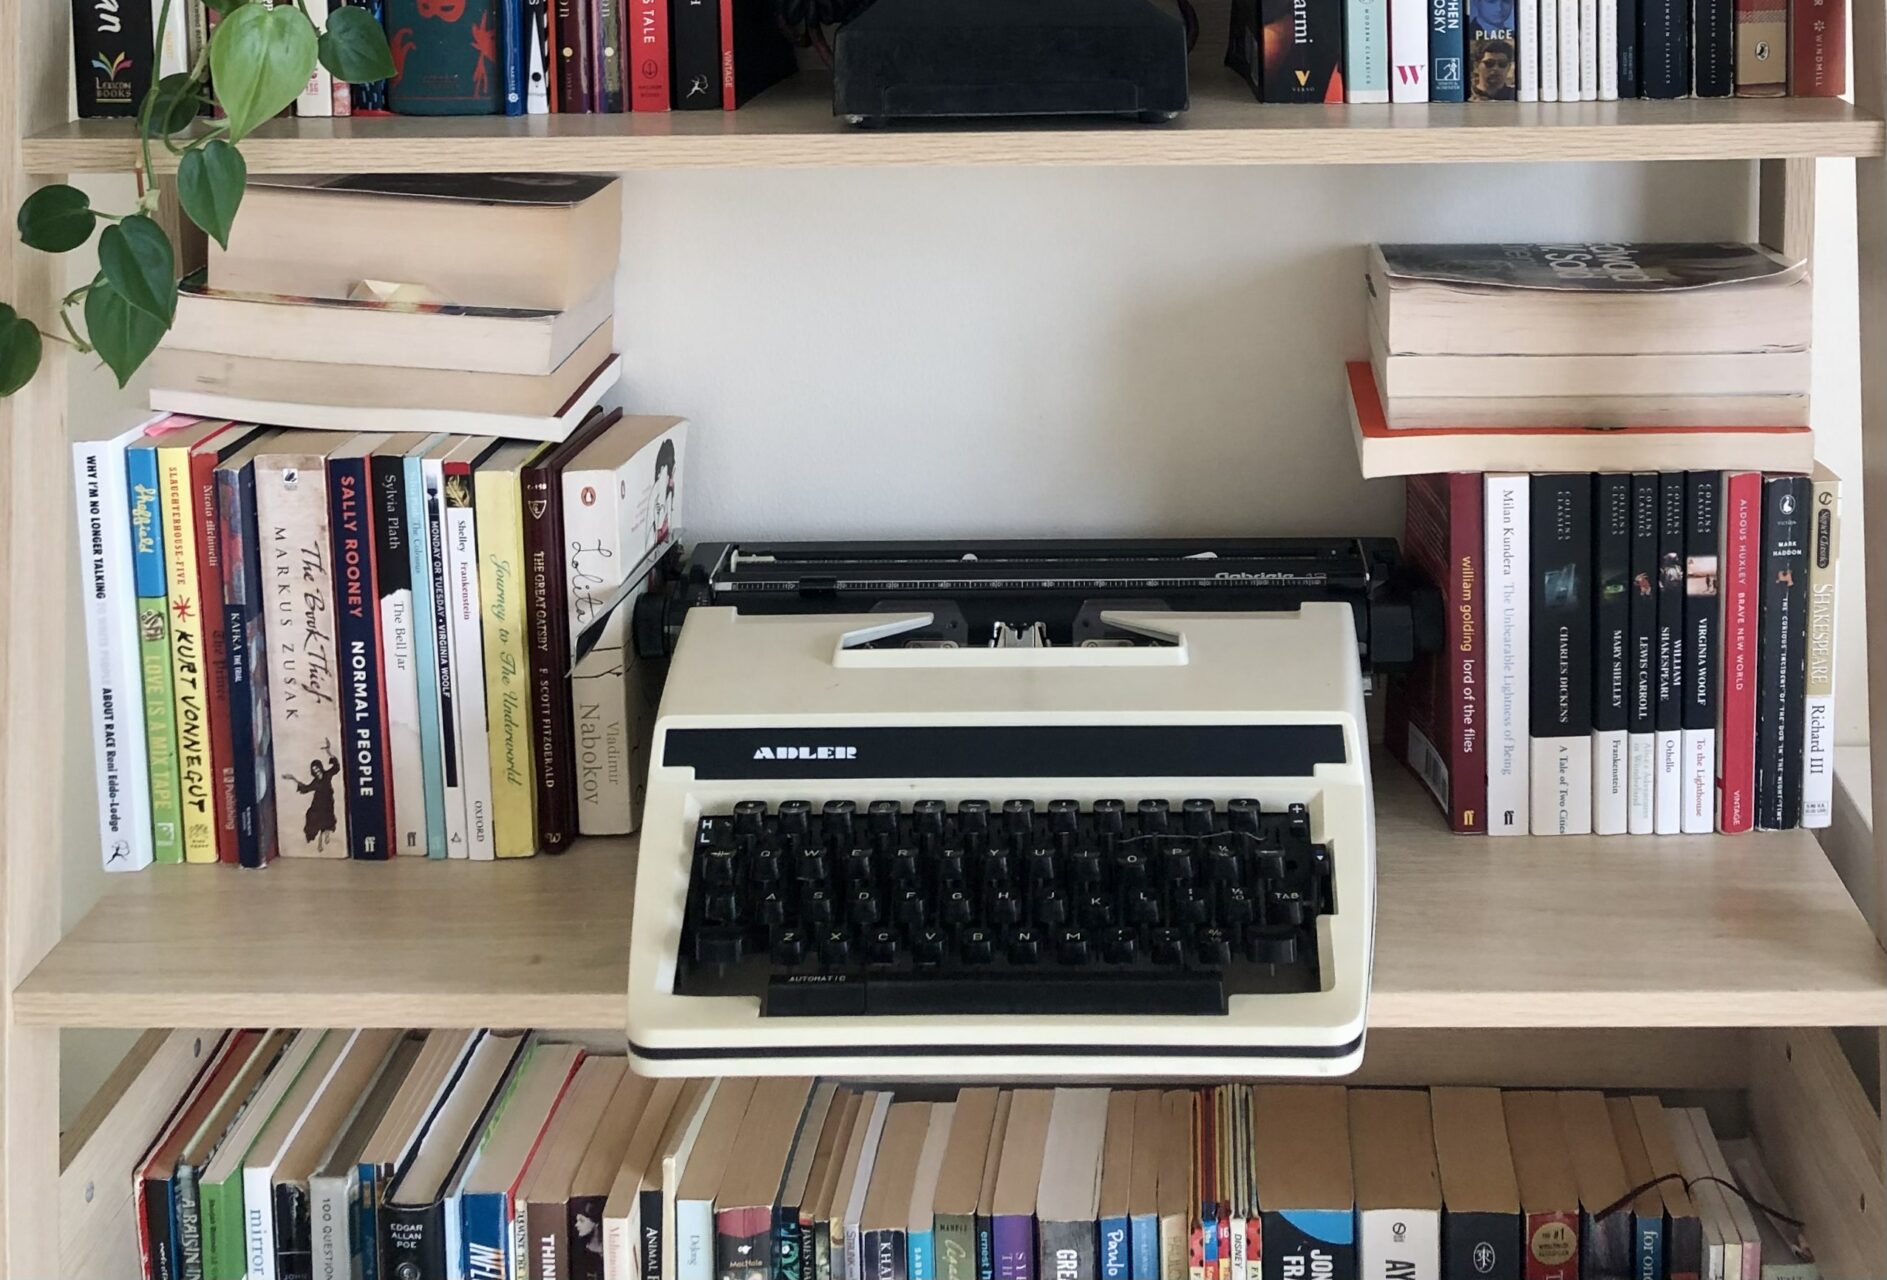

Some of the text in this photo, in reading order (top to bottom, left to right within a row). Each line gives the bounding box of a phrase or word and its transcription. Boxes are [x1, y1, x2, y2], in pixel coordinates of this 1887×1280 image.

[643, 10, 655, 43] TALE
[1475, 30, 1512, 40] PLACE
[169, 467, 185, 585] SLAUGHTERHOUSE-FIVE
[382, 475, 401, 549] Sylvia Plath
[274, 527, 299, 719] MARKUS ZUSAK
[301, 540, 333, 704] The Book Thief
[460, 562, 470, 620] Frankenstein
[1736, 499, 1747, 690] ALDOUS HUXLEY WORLD
[175, 630, 198, 689] KURT
[231, 612, 241, 650] KAFKA
[341, 476, 373, 796] SALLY ROONEY NORMAL PEOPLE
[395, 628, 407, 650] Bell
[434, 573, 450, 697] TUESDAY VIRGINIA WOOLF
[1460, 556, 1475, 753] william golding lord the flies
[1501, 490, 1515, 775] Milan Kundera Unbearable Lightness Being
[1697, 618, 1707, 706] VIRGINIA WOOLF
[1811, 584, 1832, 685] SHAKESPEARE
[90, 518, 120, 831] LONGER TALKING ABOUT RACE Eddo-Lodge
[490, 552, 523, 786] Journey The Underworld
[535, 573, 555, 788] GREAT GATSBY FITZGERALD
[1560, 626, 1568, 723] CHARLES DICKENS
[1639, 636, 1648, 720] LEWIS CARROLL
[144, 656, 171, 810] LOVE TAPE
[181, 696, 207, 812] VONNEGUT
[580, 704, 602, 804] Nabokov
[607, 722, 621, 784] Vladimir
[753, 746, 858, 760] ADLER
[1666, 740, 1675, 773] Othello
[1810, 705, 1825, 775] Richard III
[475, 800, 485, 842] OXFORD
[1694, 769, 1706, 817] Lighthouse
[251, 1210, 268, 1275] mirror
[322, 1198, 331, 1225] 100
[391, 1232, 421, 1240] ALLAN
[1644, 1232, 1658, 1253] for
[646, 1227, 658, 1271] ANIMAL
[981, 1231, 991, 1266] ernest
[1234, 1234, 1242, 1269] DISNEY
